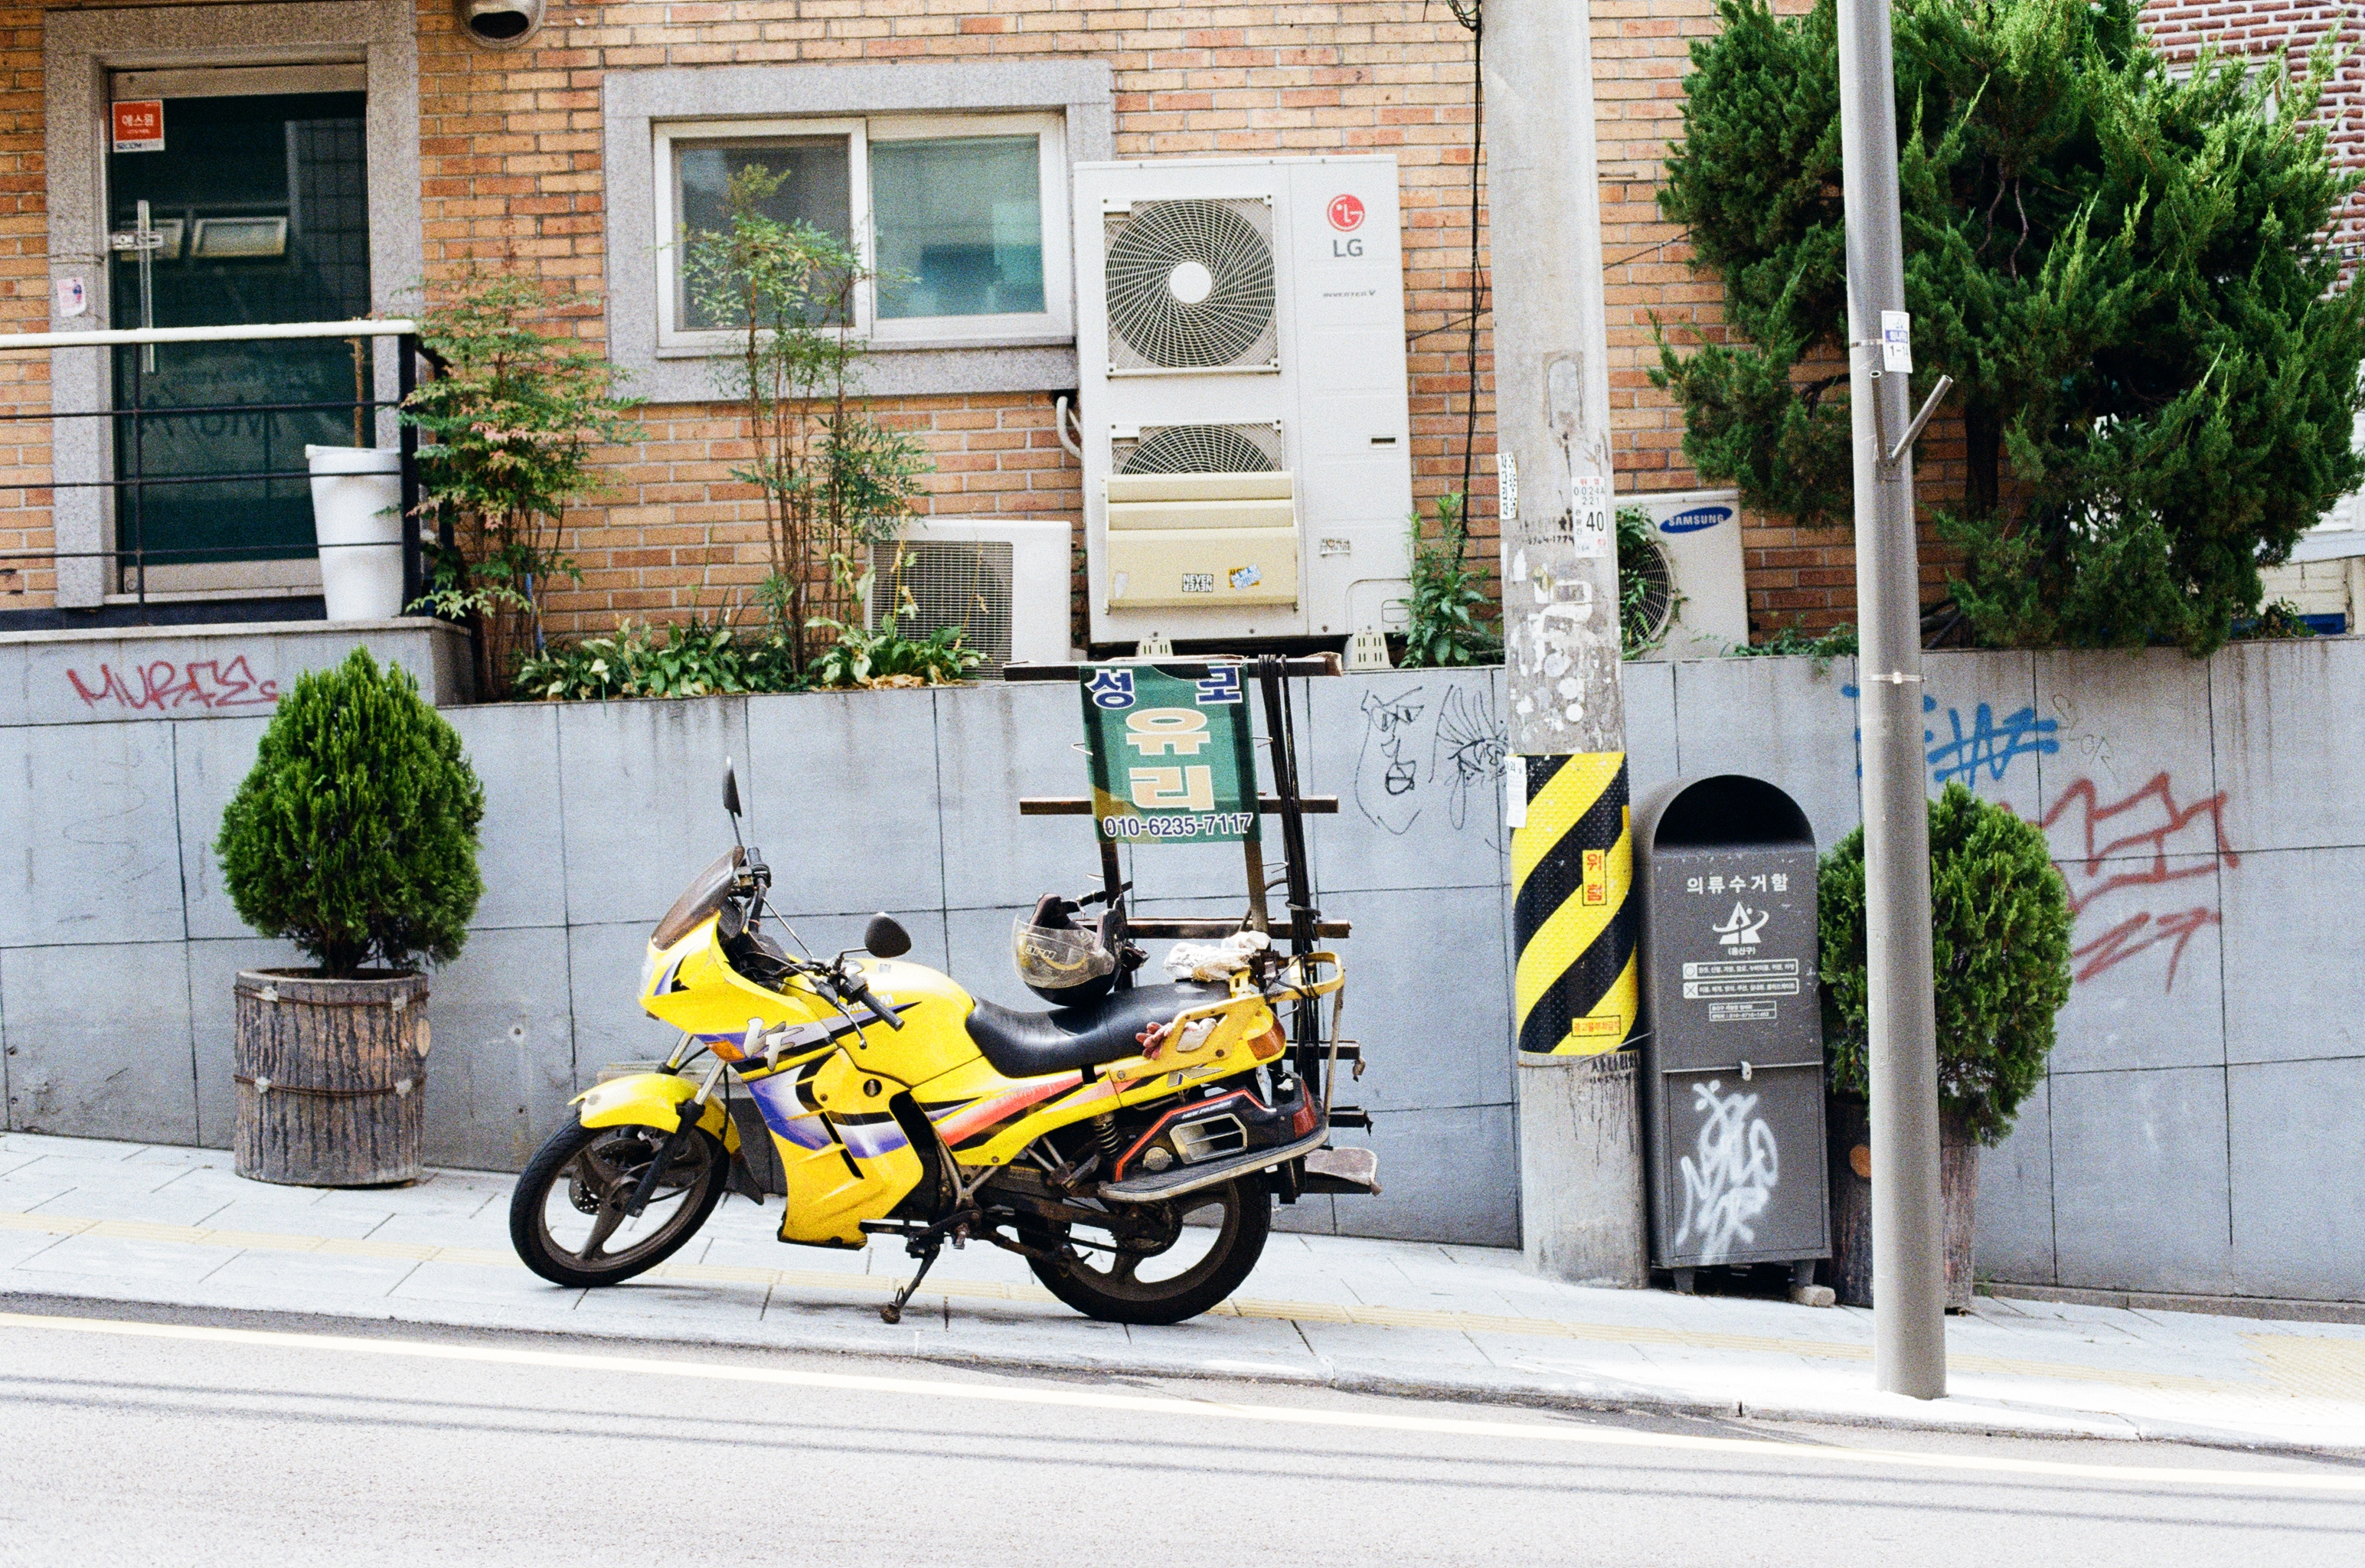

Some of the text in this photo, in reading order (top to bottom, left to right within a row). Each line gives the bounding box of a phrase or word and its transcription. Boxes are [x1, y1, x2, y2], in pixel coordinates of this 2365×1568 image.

[1333, 238, 1363, 257] LG
[1586, 511, 1605, 532] 40
[1669, 514, 1724, 527] SAMSUNG
[1183, 574, 1213, 583] NEVER
[1183, 583, 1213, 592] NEVER
[1125, 707, 1216, 812] 유리
[1102, 812, 1253, 838] 010-6235-7117
[1687, 873, 1788, 894] 의류수거함
[1727, 946, 1756, 956] (용산구)
[743, 1017, 805, 1072] VF
